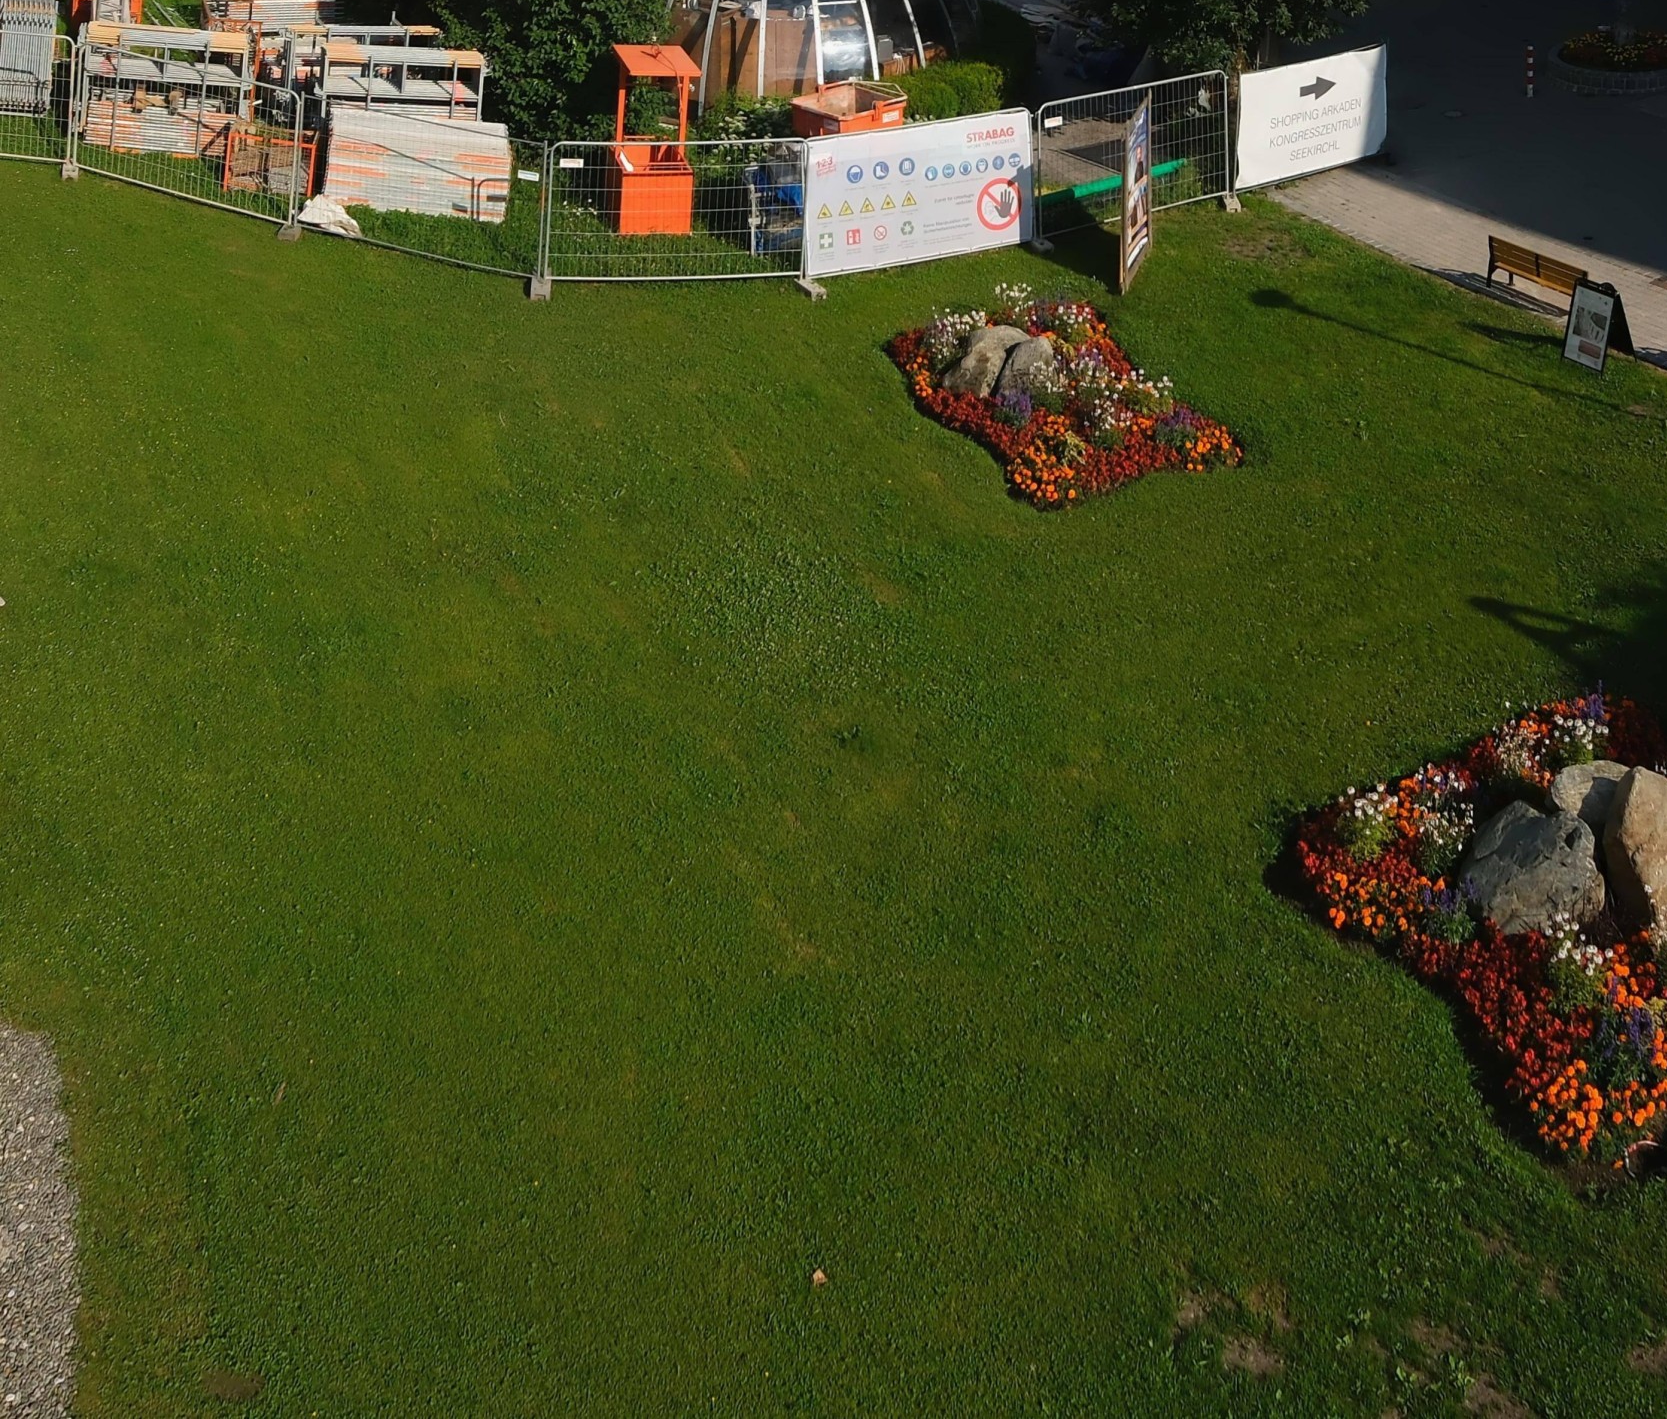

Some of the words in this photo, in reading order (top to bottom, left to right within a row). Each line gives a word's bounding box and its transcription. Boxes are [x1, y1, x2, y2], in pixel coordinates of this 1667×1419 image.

[1270, 109, 1319, 129] SHOPPING
[1321, 98, 1362, 118] ARKADEN
[966, 127, 1015, 143] STRABAG
[1270, 116, 1362, 148] KONGRESSZENTRUM
[1290, 140, 1340, 161] SEEKIRCHL
